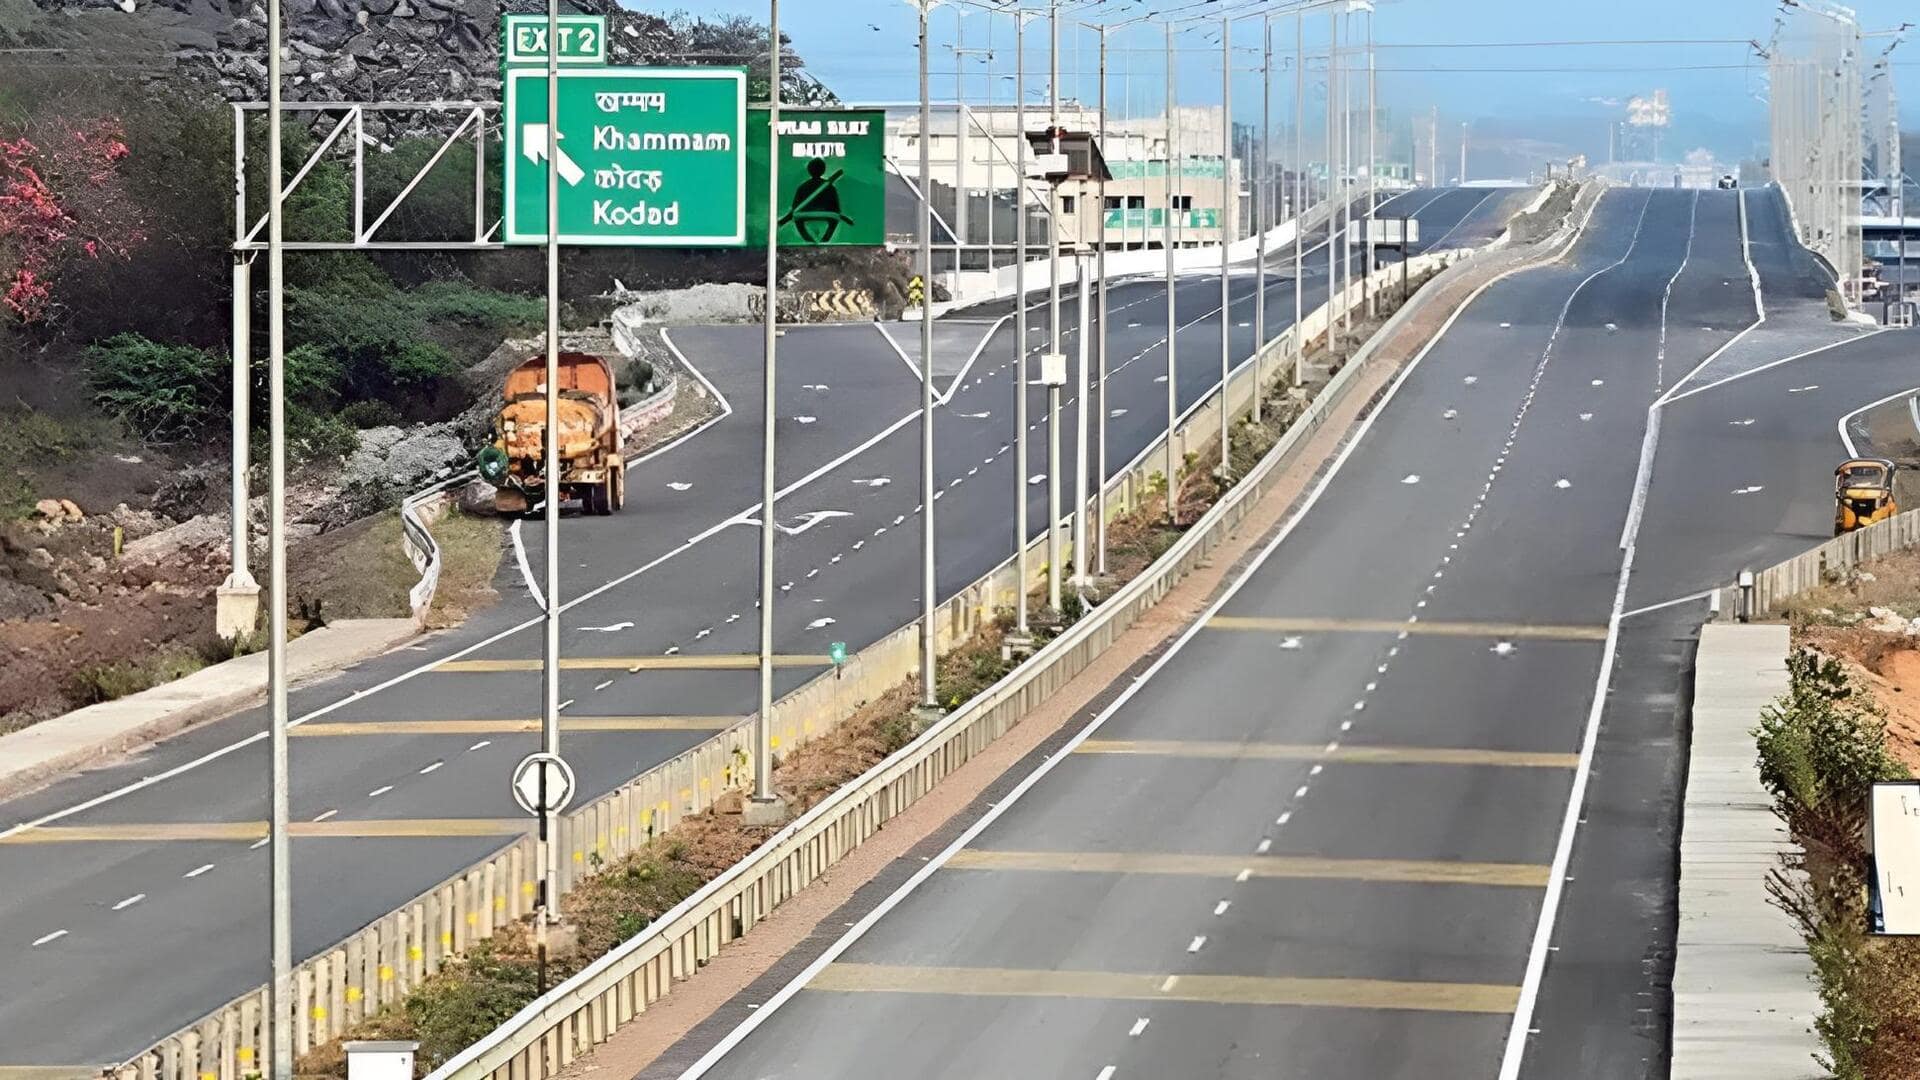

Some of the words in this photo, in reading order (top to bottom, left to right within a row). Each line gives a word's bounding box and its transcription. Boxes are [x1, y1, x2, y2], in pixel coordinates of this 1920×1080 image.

[517, 27, 573, 52] EXT
[578, 27, 595, 52] 2
[593, 125, 730, 150] Khammam
[593, 200, 679, 225] Kodad
